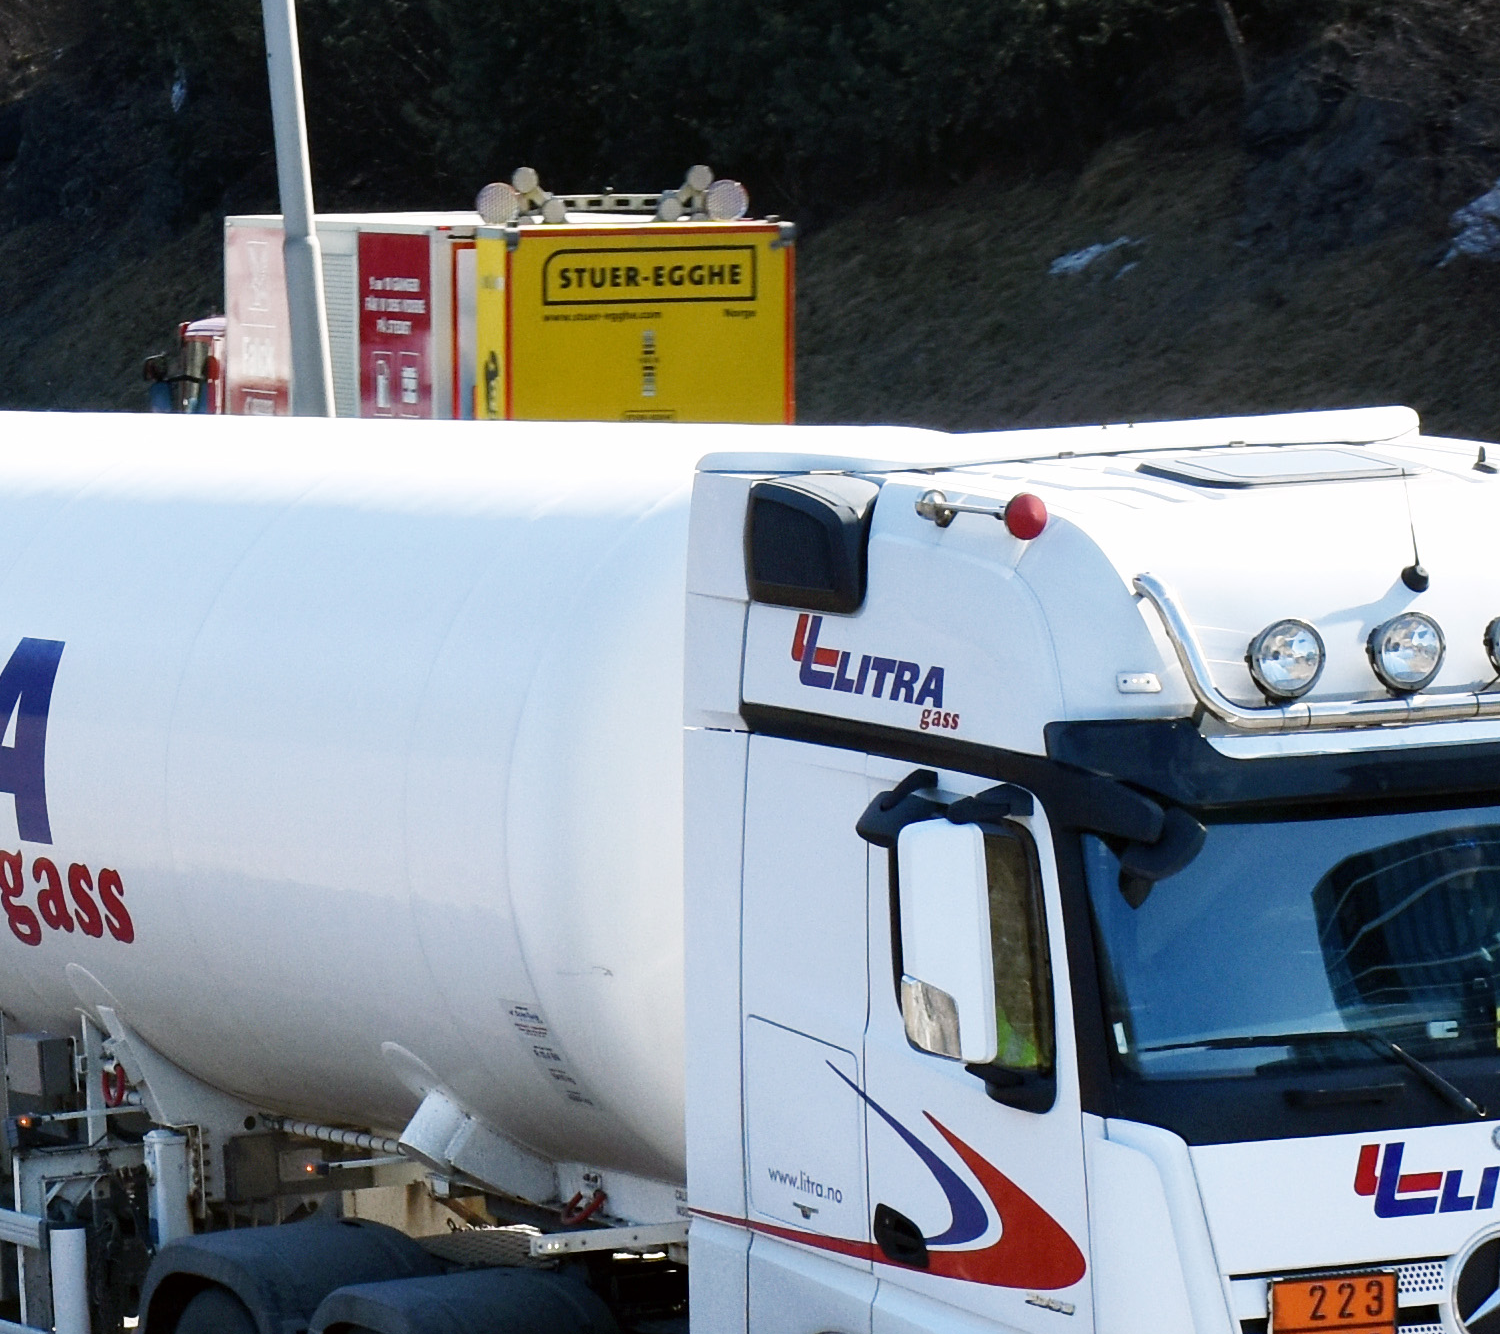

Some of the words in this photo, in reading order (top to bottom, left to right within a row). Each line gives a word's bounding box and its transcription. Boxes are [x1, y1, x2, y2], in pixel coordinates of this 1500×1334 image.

[559, 263, 742, 288] STUER-EGGHE
[833, 650, 945, 708] LITRA
[919, 708, 960, 730] gass
[768, 1168, 843, 1204] www.litra.no
[1308, 1280, 1385, 1321] 223
